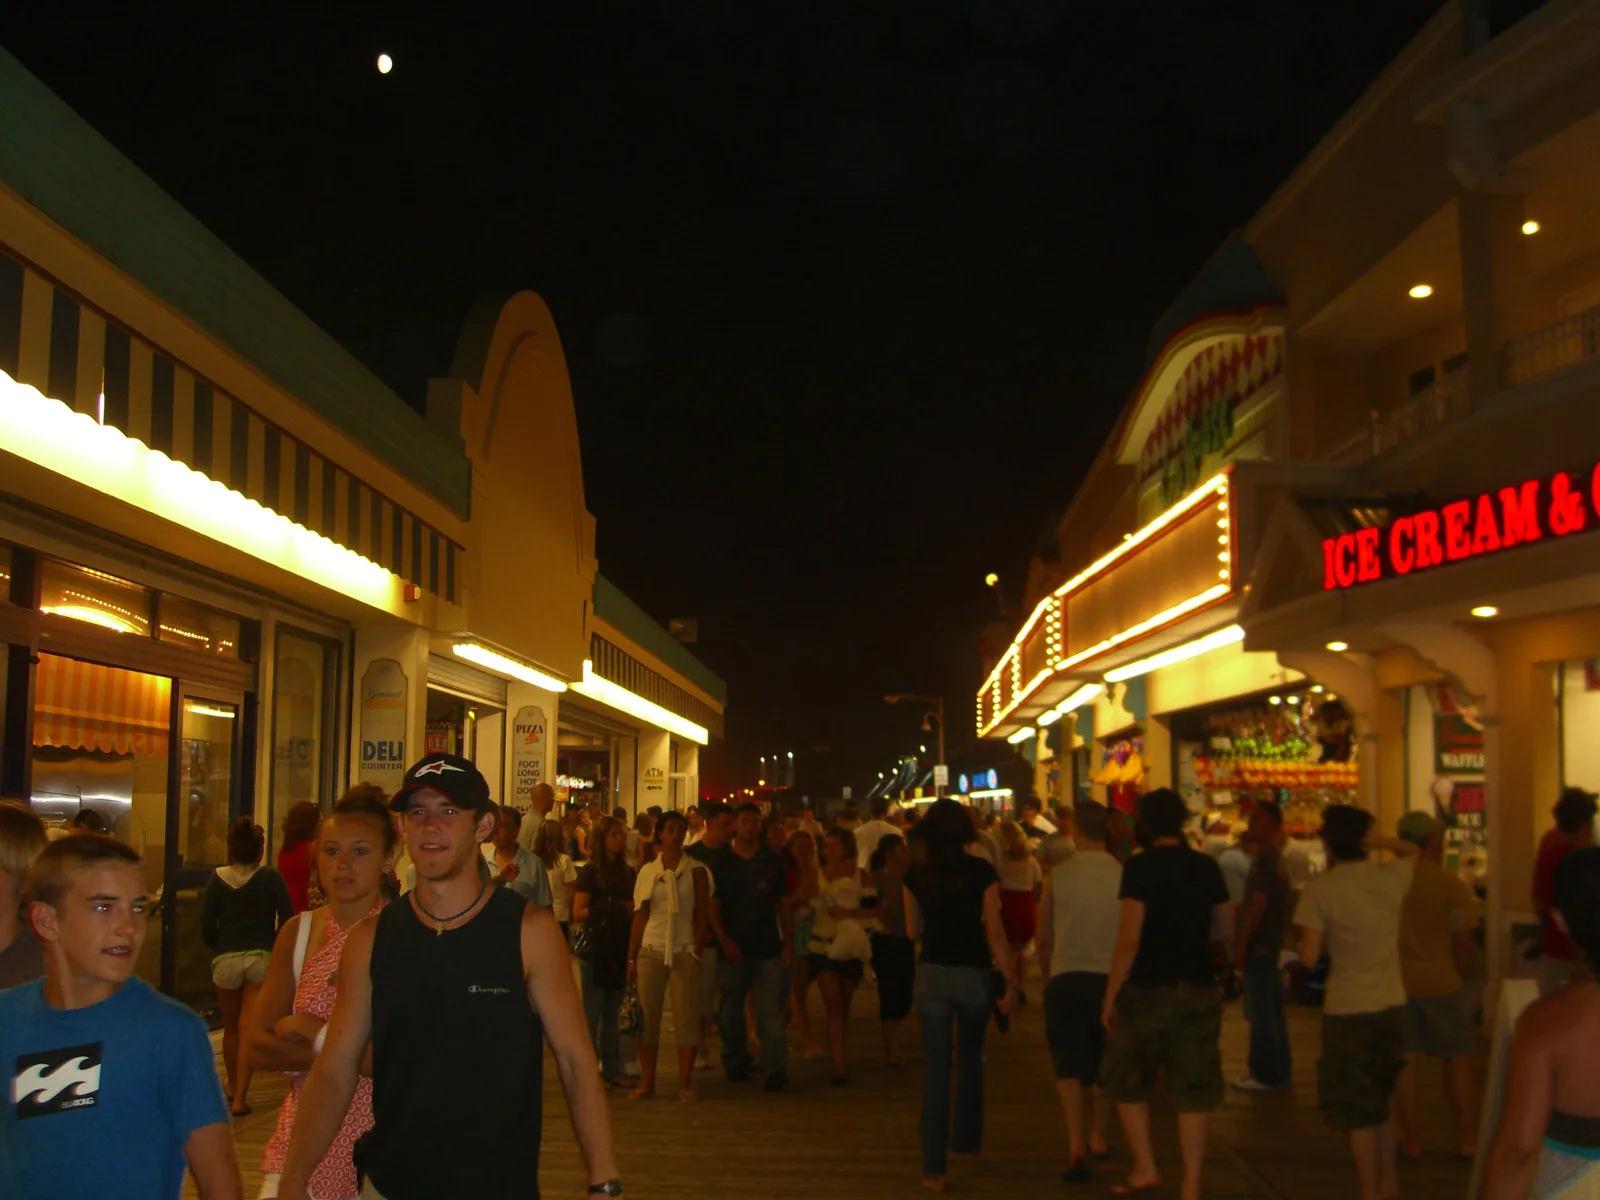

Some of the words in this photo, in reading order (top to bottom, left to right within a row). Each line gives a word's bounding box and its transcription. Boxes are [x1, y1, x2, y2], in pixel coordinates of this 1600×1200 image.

[1322, 527, 1381, 590] ICE
[1389, 479, 1542, 575] CREAM
[1549, 471, 1586, 537] &
[516, 724, 544, 734] PIZZA
[362, 740, 404, 761] DELI
[361, 762, 403, 770] COUNTER
[518, 760, 540, 768] FOOT
[517, 769, 541, 777] LONG
[644, 767, 664, 778] ATM
[519, 778, 537, 786] HOT
[468, 985, 511, 995] Champion
